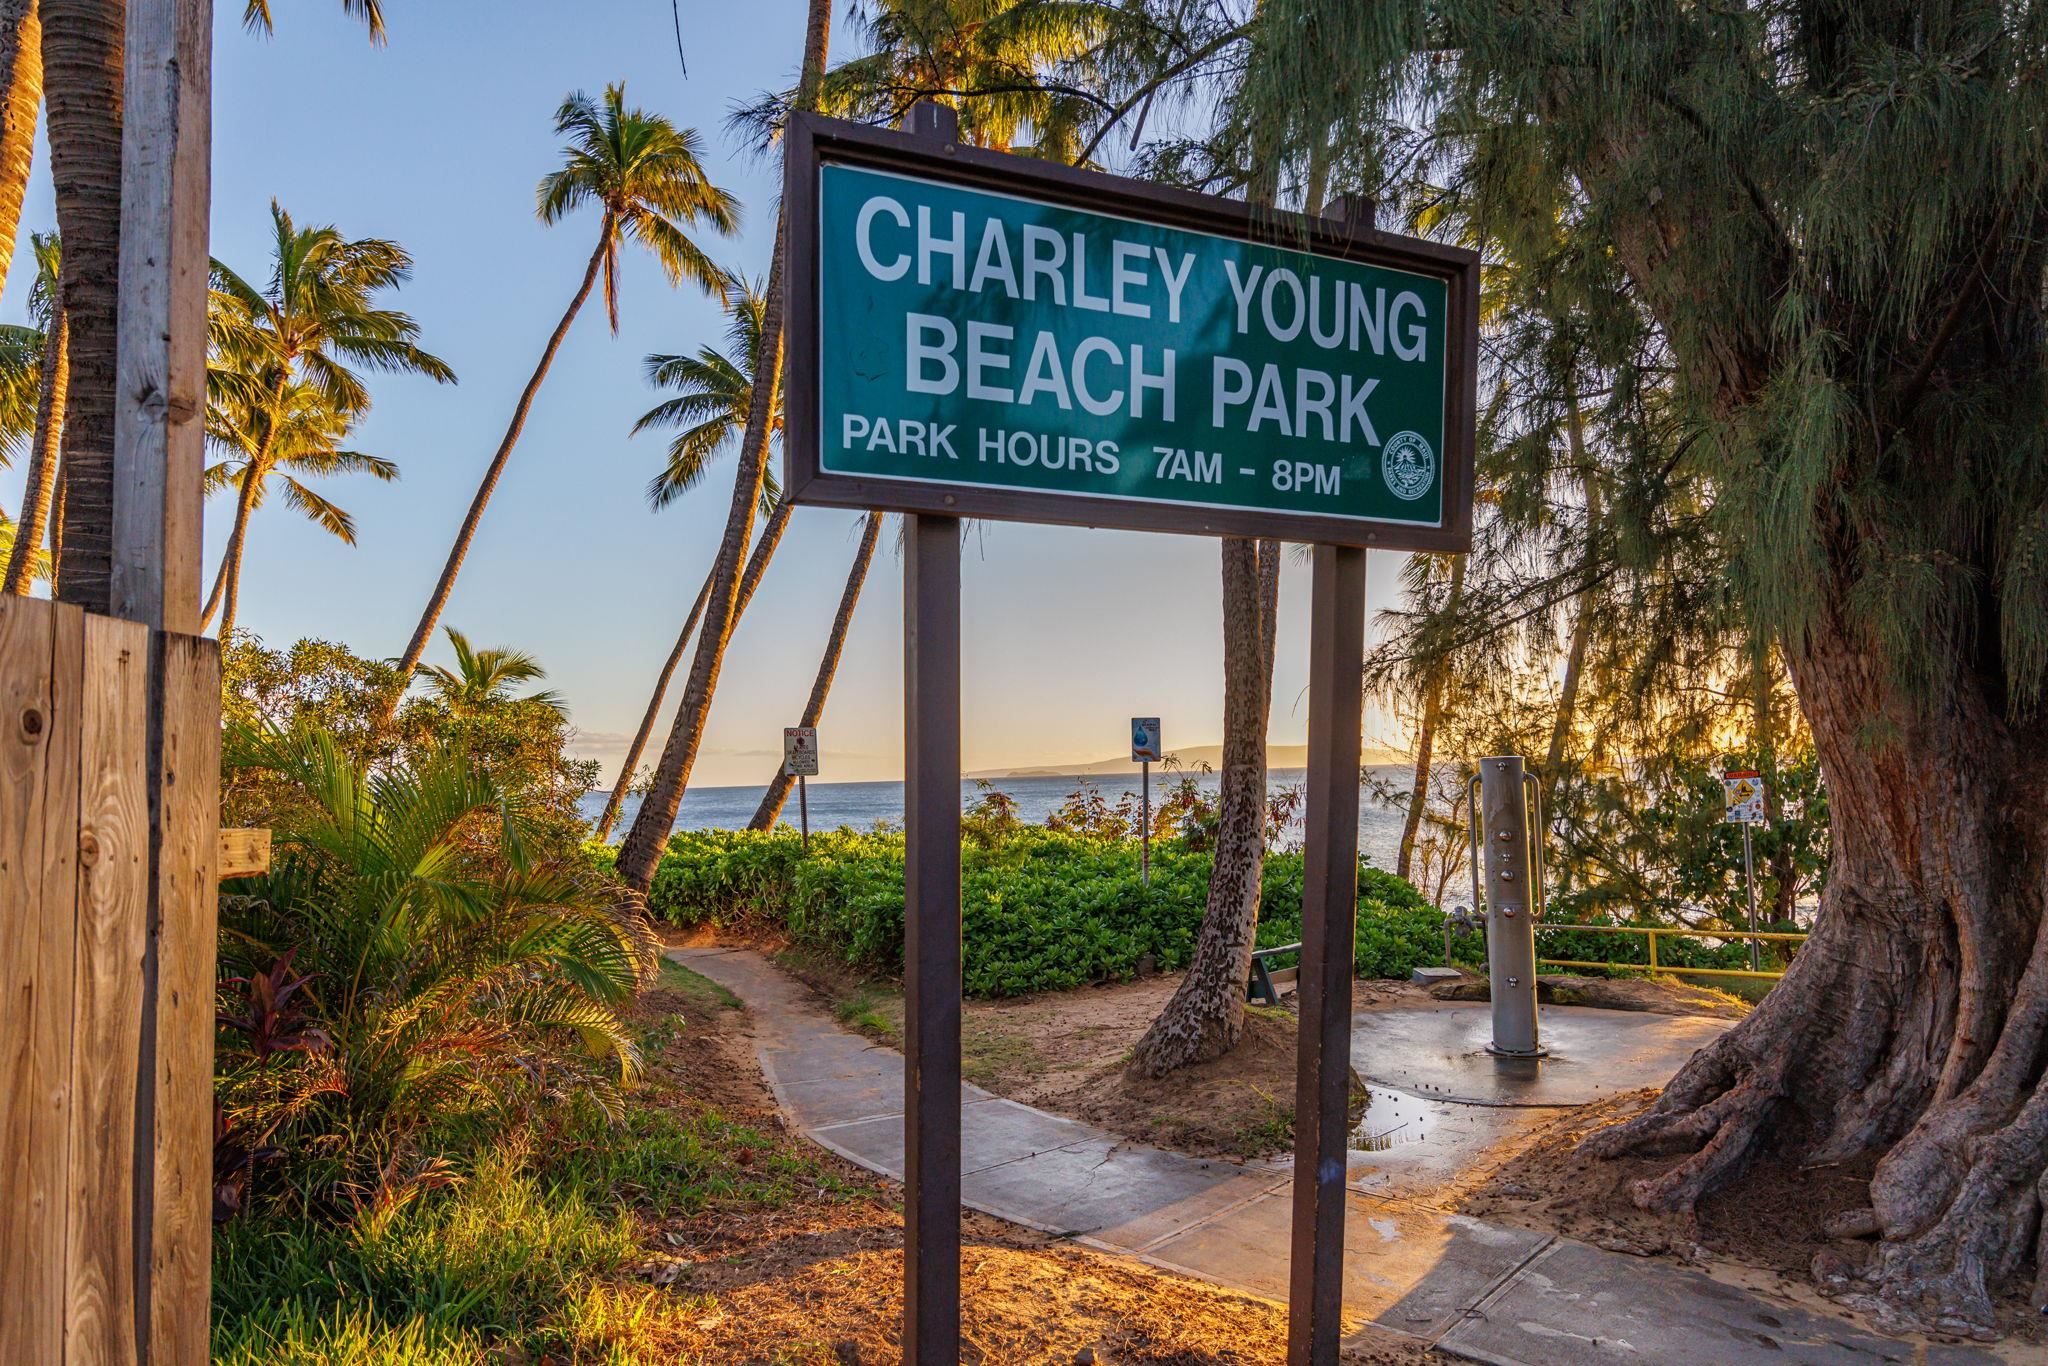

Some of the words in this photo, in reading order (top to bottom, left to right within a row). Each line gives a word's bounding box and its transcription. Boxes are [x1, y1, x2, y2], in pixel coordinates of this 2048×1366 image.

[855, 196, 1196, 323] CHARLEY
[1224, 260, 1427, 362] YOUNG
[906, 312, 1176, 422] BEACH
[1212, 355, 1381, 447] PARK
[843, 414, 959, 459] PARK
[978, 428, 1120, 474] HOURS
[1152, 446, 1222, 484] 7AM
[1272, 459, 1341, 496] 8PM
[1389, 437, 1407, 454] COUNTY
[1418, 443, 1429, 460] MAUI
[786, 729, 815, 737] NOTICE
